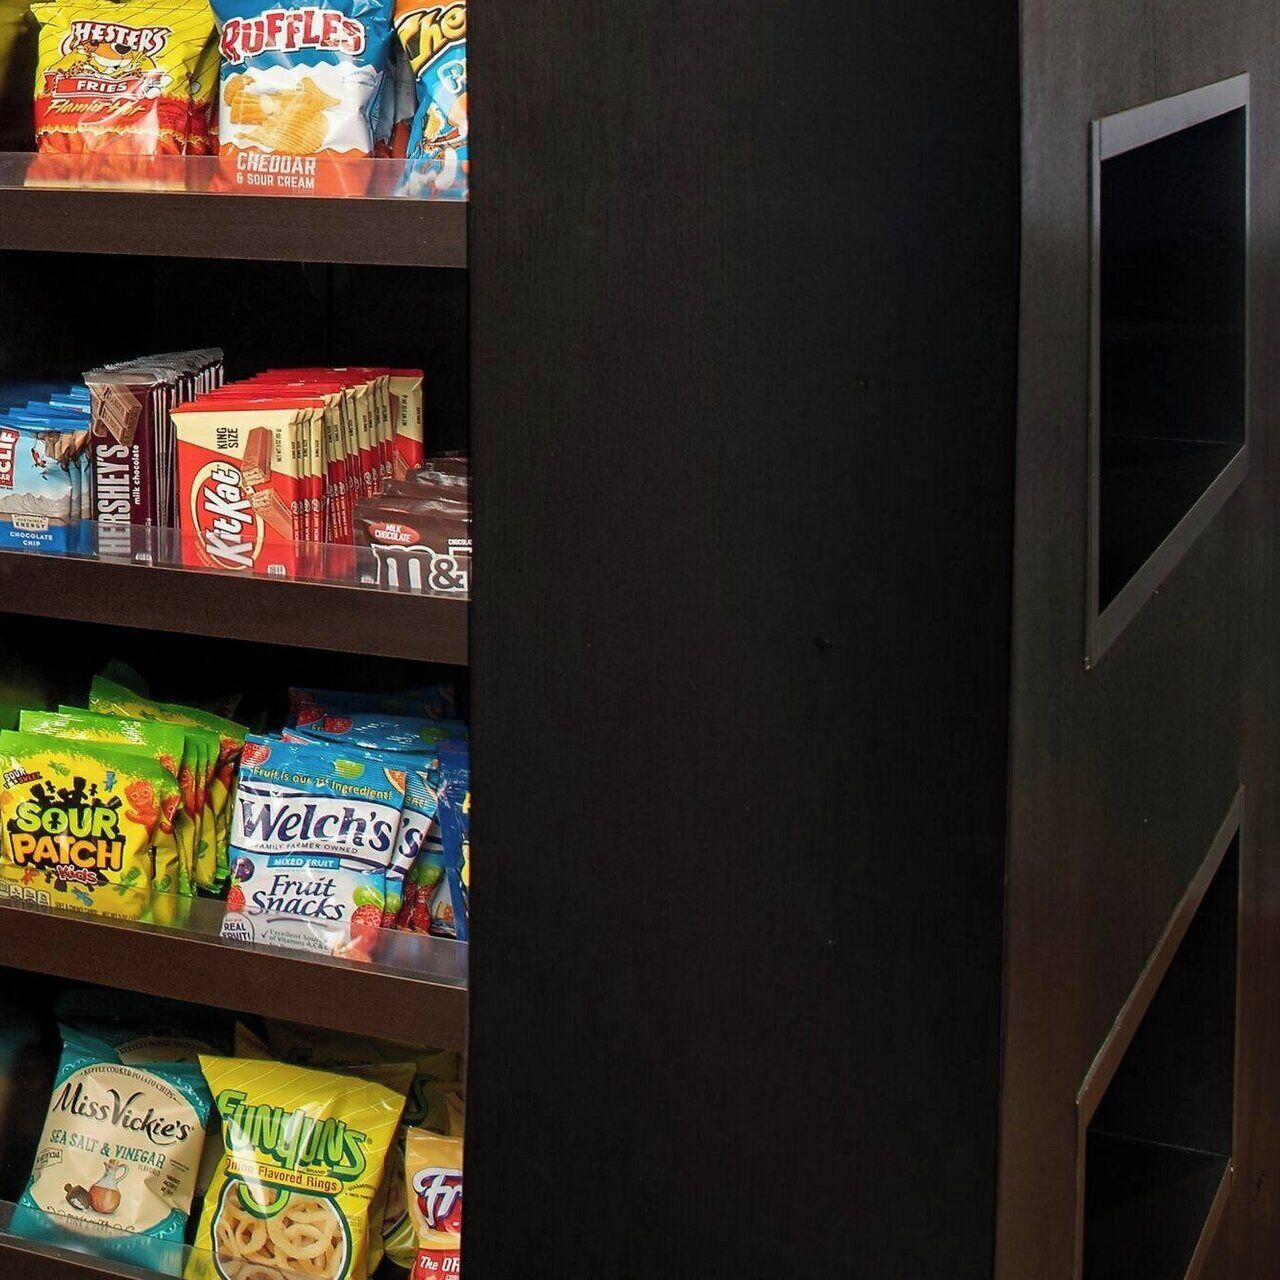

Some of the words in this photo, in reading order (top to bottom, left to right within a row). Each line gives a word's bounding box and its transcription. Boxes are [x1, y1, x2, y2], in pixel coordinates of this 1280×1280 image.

[220, 6, 366, 65] RUFFLES
[77, 80, 128, 93] FRIES
[237, 150, 317, 176] CHEDDAR
[246, 175, 274, 187] SOUR
[277, 177, 316, 190] CREAM
[217, 427, 227, 450] KING
[228, 426, 239, 449] SIZE
[132, 445, 140, 483] chocolate
[97, 444, 131, 554] HERSHEY'S
[132, 484, 140, 505] milk
[206, 463, 254, 567] KitKat
[9, 531, 53, 541] CHOCOLATE
[375, 530, 412, 543] CHOCOLATE
[385, 524, 401, 532] MILK
[252, 767, 279, 779] Fruit
[291, 776, 313, 785] our
[331, 781, 393, 800] Ingredient!
[16, 800, 117, 840] SOUR
[239, 798, 392, 852] Welch's
[11, 832, 123, 871] PATCH
[286, 842, 321, 851] FARMER
[323, 844, 359, 855] OWNED
[56, 864, 99, 885] Kids
[273, 858, 303, 867] MIXED
[307, 859, 335, 868] FRUIT
[268, 874, 338, 897] Fruit
[248, 891, 346, 921] Snacks
[224, 922, 247, 931] REAL
[52, 1082, 110, 1120] Miss
[107, 1087, 192, 1146] Vickie's
[50, 1129, 68, 1145] SEA
[70, 1133, 99, 1153] SALT
[100, 1142, 111, 1158] &
[115, 1145, 167, 1169] VINEGAR
[257, 1163, 303, 1184] Flavored
[306, 1176, 338, 1192] Rings
[419, 1256, 439, 1271] The
